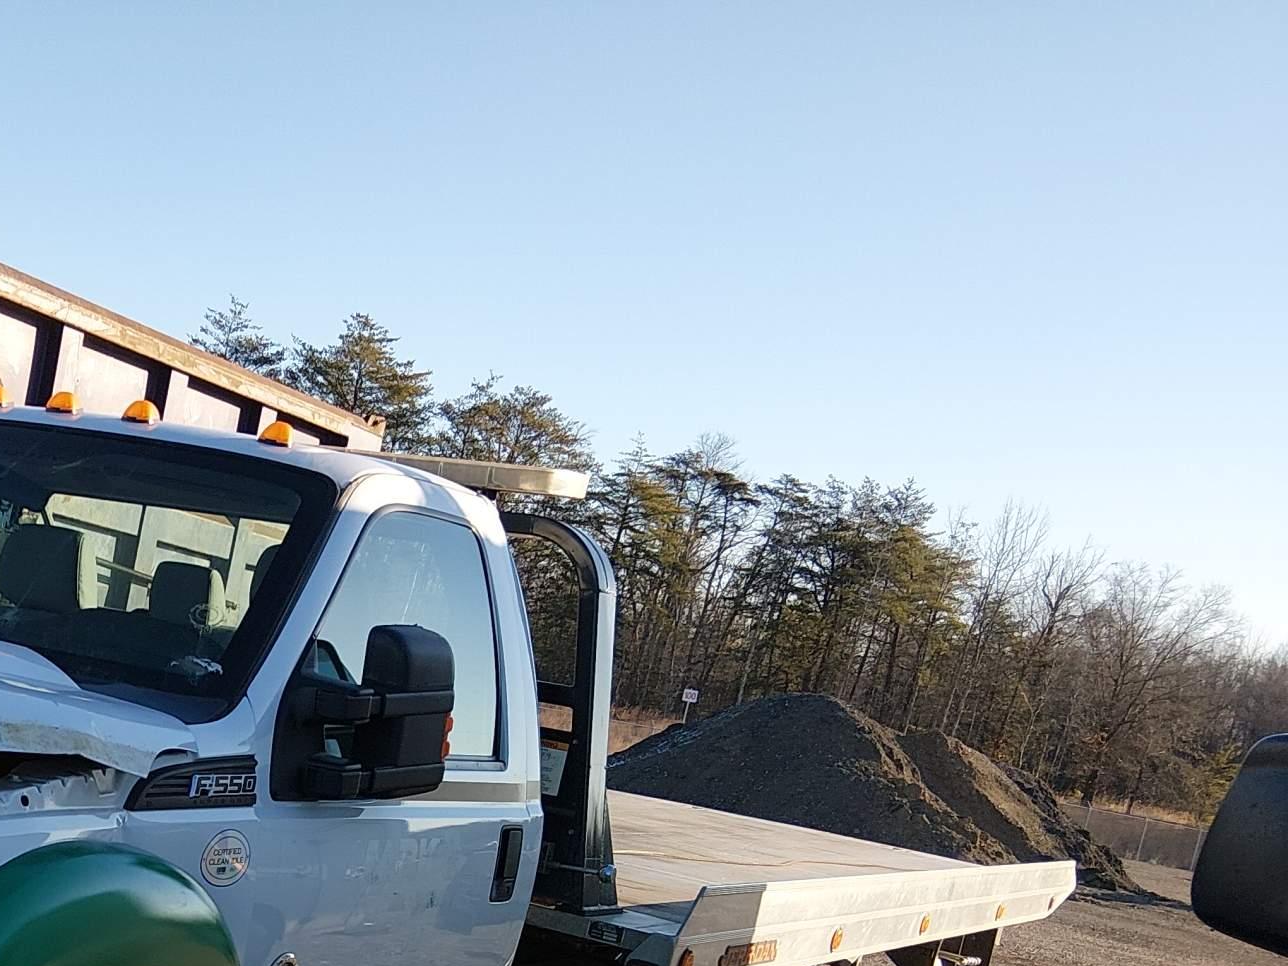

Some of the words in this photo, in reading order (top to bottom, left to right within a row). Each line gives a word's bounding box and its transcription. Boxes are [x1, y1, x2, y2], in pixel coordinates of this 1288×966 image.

[189, 774, 257, 797] F-550
[213, 847, 242, 857] CERTIFIED
[208, 857, 229, 865] CLEAN
